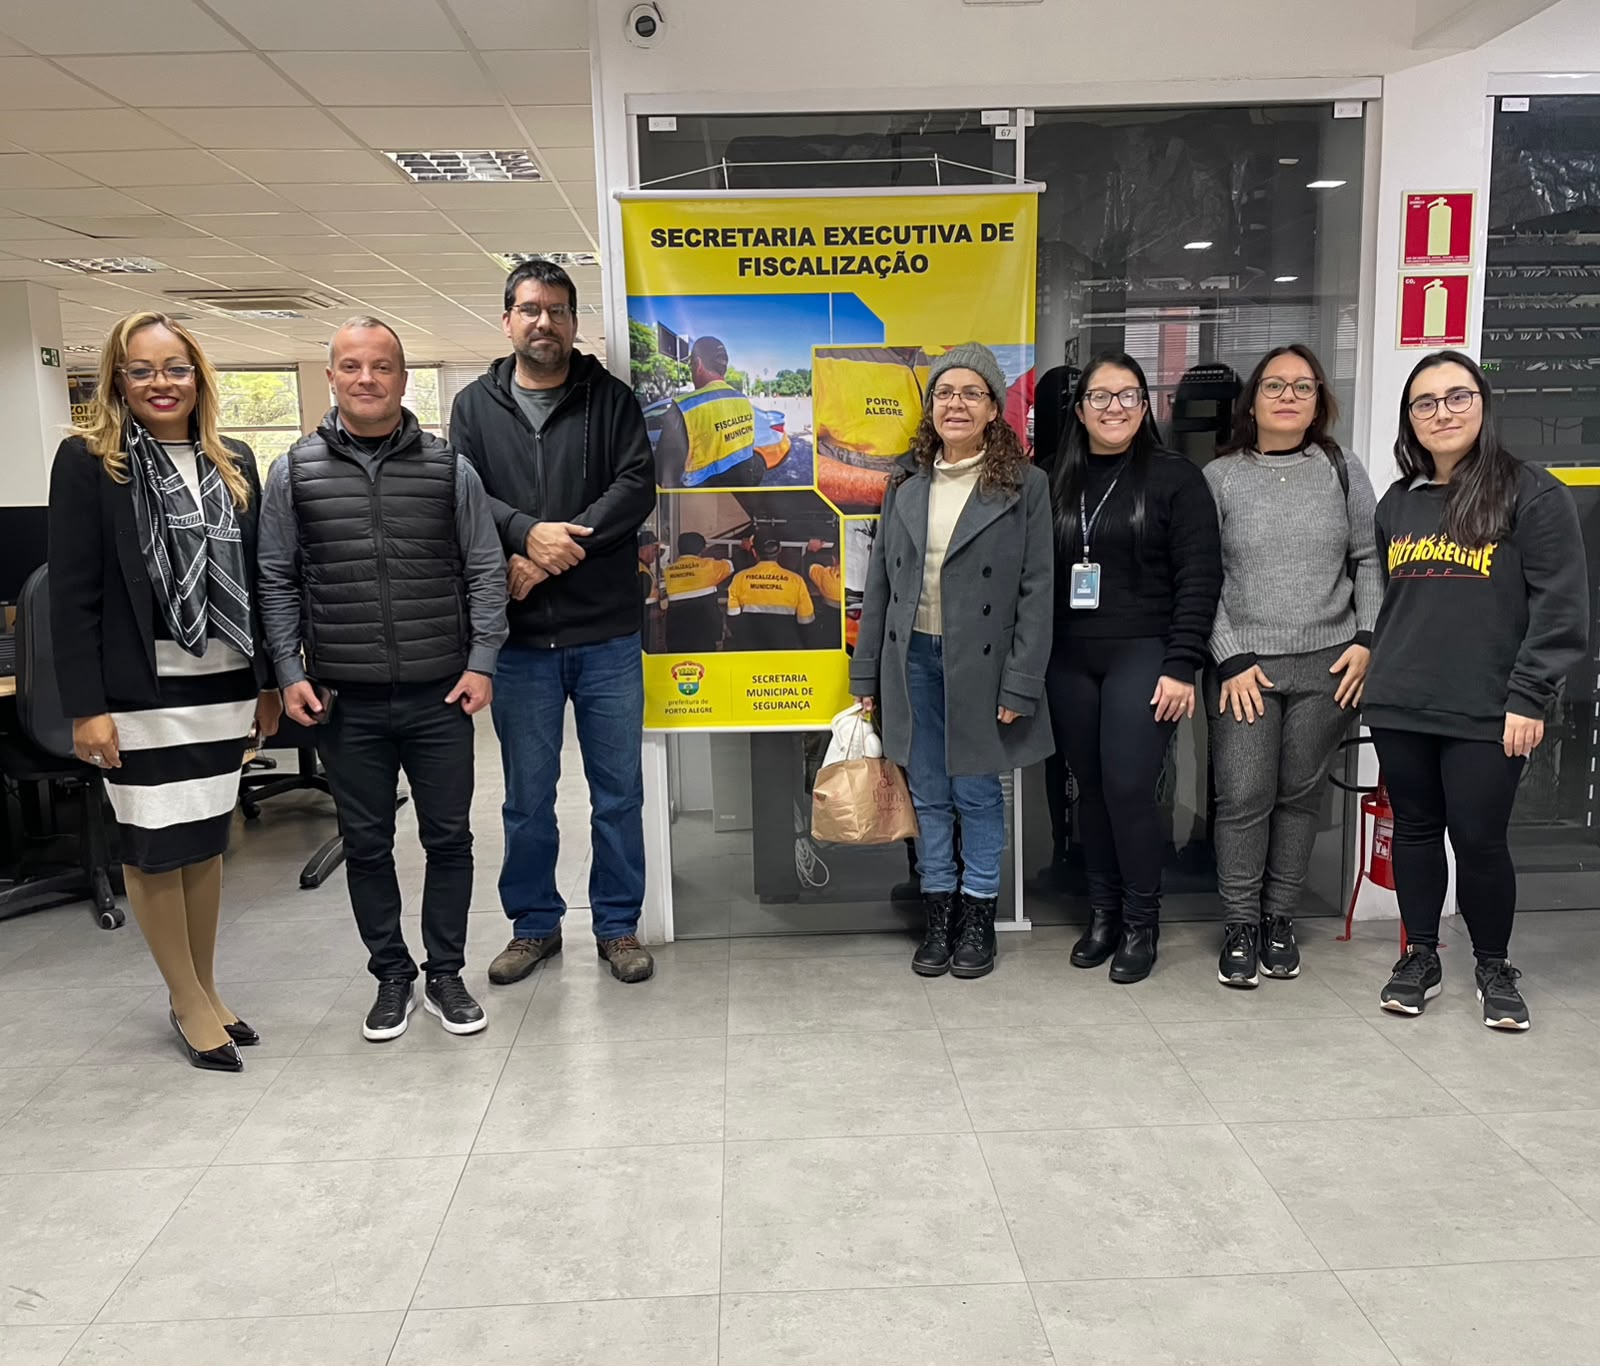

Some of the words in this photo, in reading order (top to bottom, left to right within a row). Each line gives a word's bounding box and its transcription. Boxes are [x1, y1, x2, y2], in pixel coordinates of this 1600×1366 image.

[1001, 129, 1011, 137] 67
[650, 227, 816, 248] SECRETARIA
[824, 223, 973, 246] EXECUTIVA
[981, 222, 1014, 242] DE
[738, 251, 929, 278] FISCALIZAÇÃO
[865, 397, 899, 407] PORTO
[865, 407, 903, 416] ALEGRE
[1399, 568, 1453, 576] FIRE
[745, 573, 789, 581] FISCALIZAÇÃO
[752, 674, 808, 683] SECRETARIA
[746, 687, 799, 697] MUNICIPAL
[801, 687, 814, 696] DE
[668, 698, 699, 706] prefeitura
[753, 700, 811, 710] SEGURANÇA
